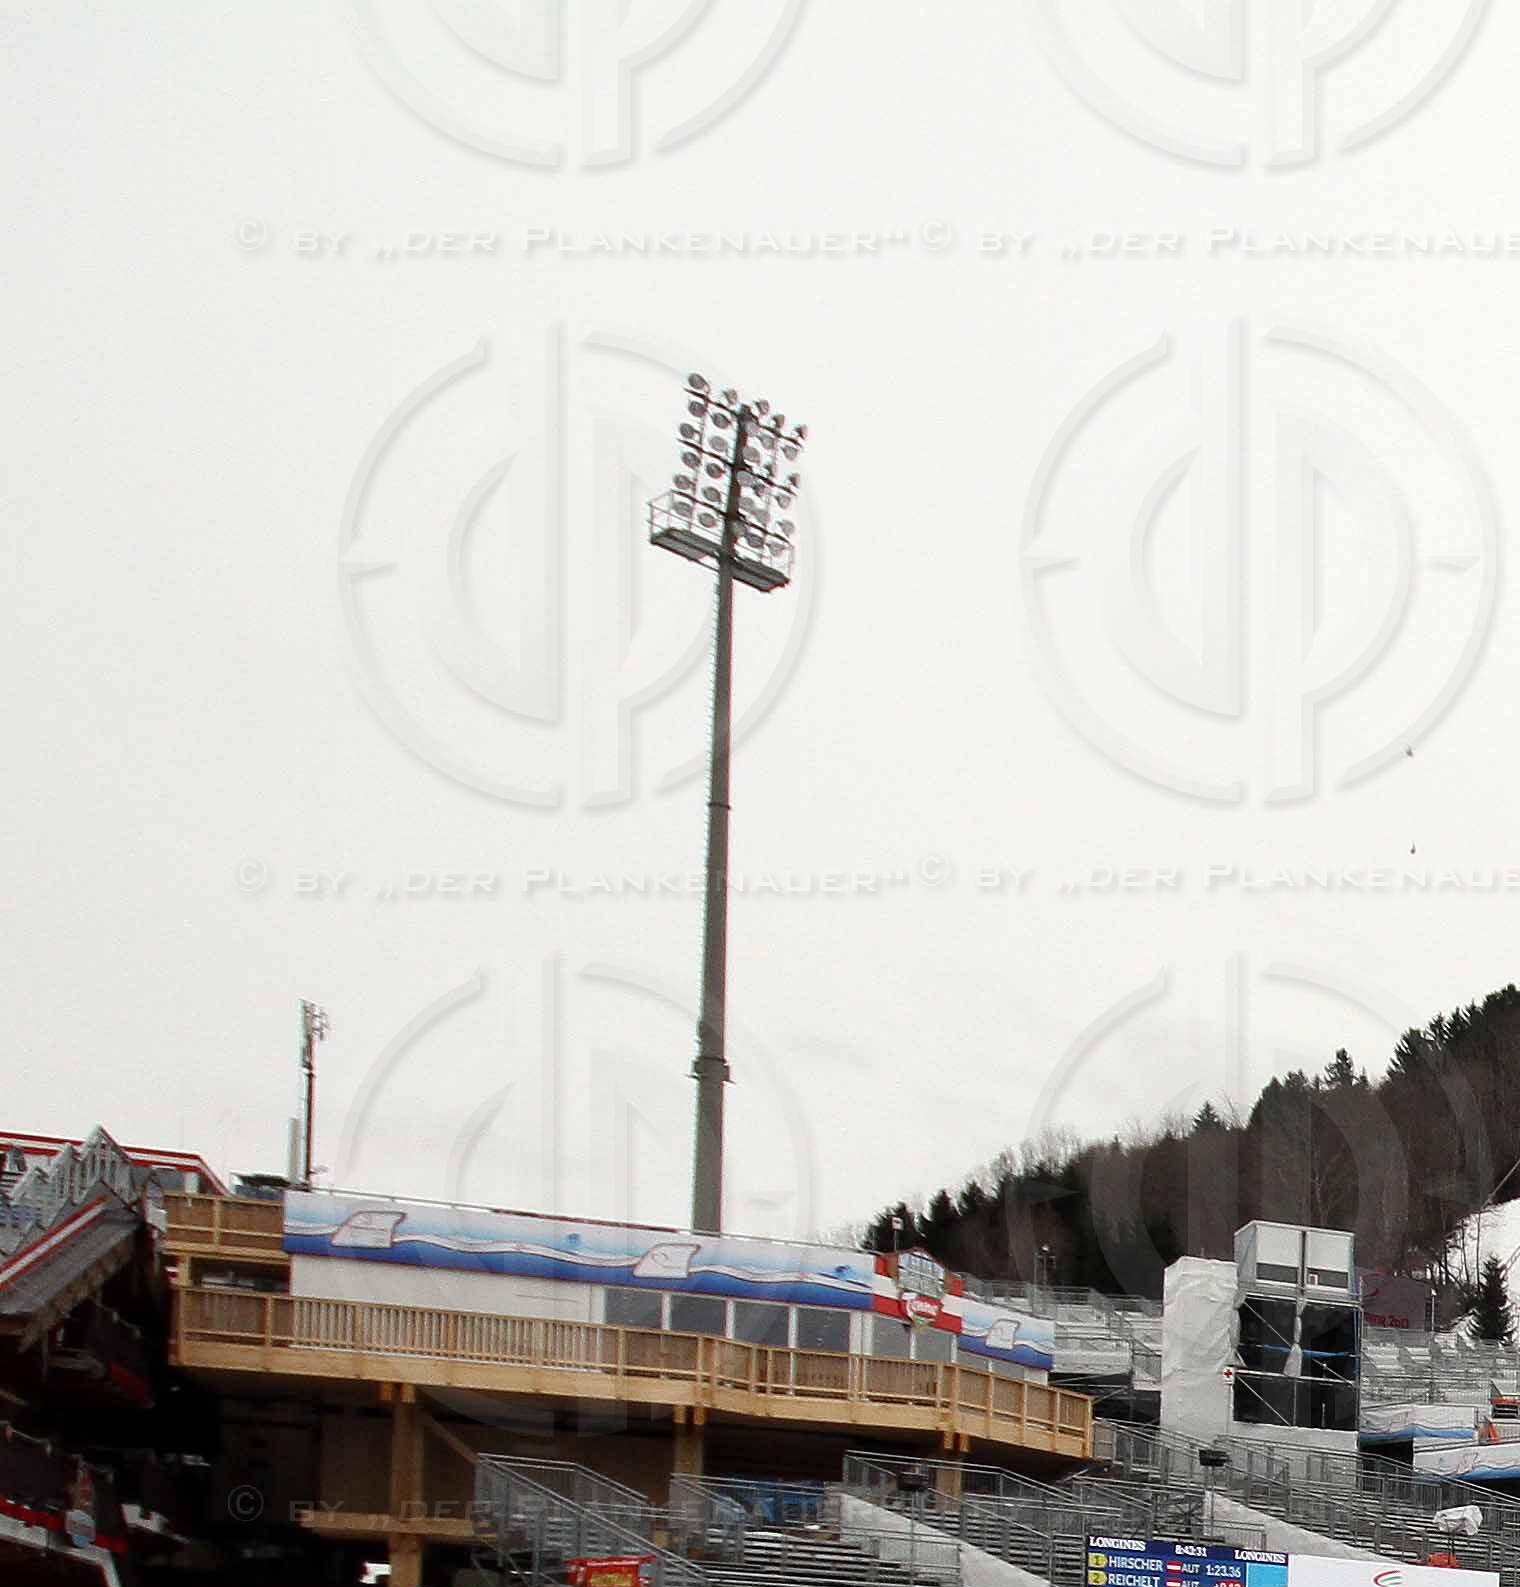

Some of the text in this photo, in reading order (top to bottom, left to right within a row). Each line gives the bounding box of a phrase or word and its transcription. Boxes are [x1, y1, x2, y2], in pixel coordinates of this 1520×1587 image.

[1089, 1536, 1146, 1551] LONGINES
[1234, 1550, 1287, 1564] LONGINES
[1108, 1556, 1164, 1572] HIRSCHER
[1182, 1564, 1200, 1574] AUT
[1206, 1564, 1242, 1578] 1:23.36
[1108, 1574, 1160, 1587] REICHELT
